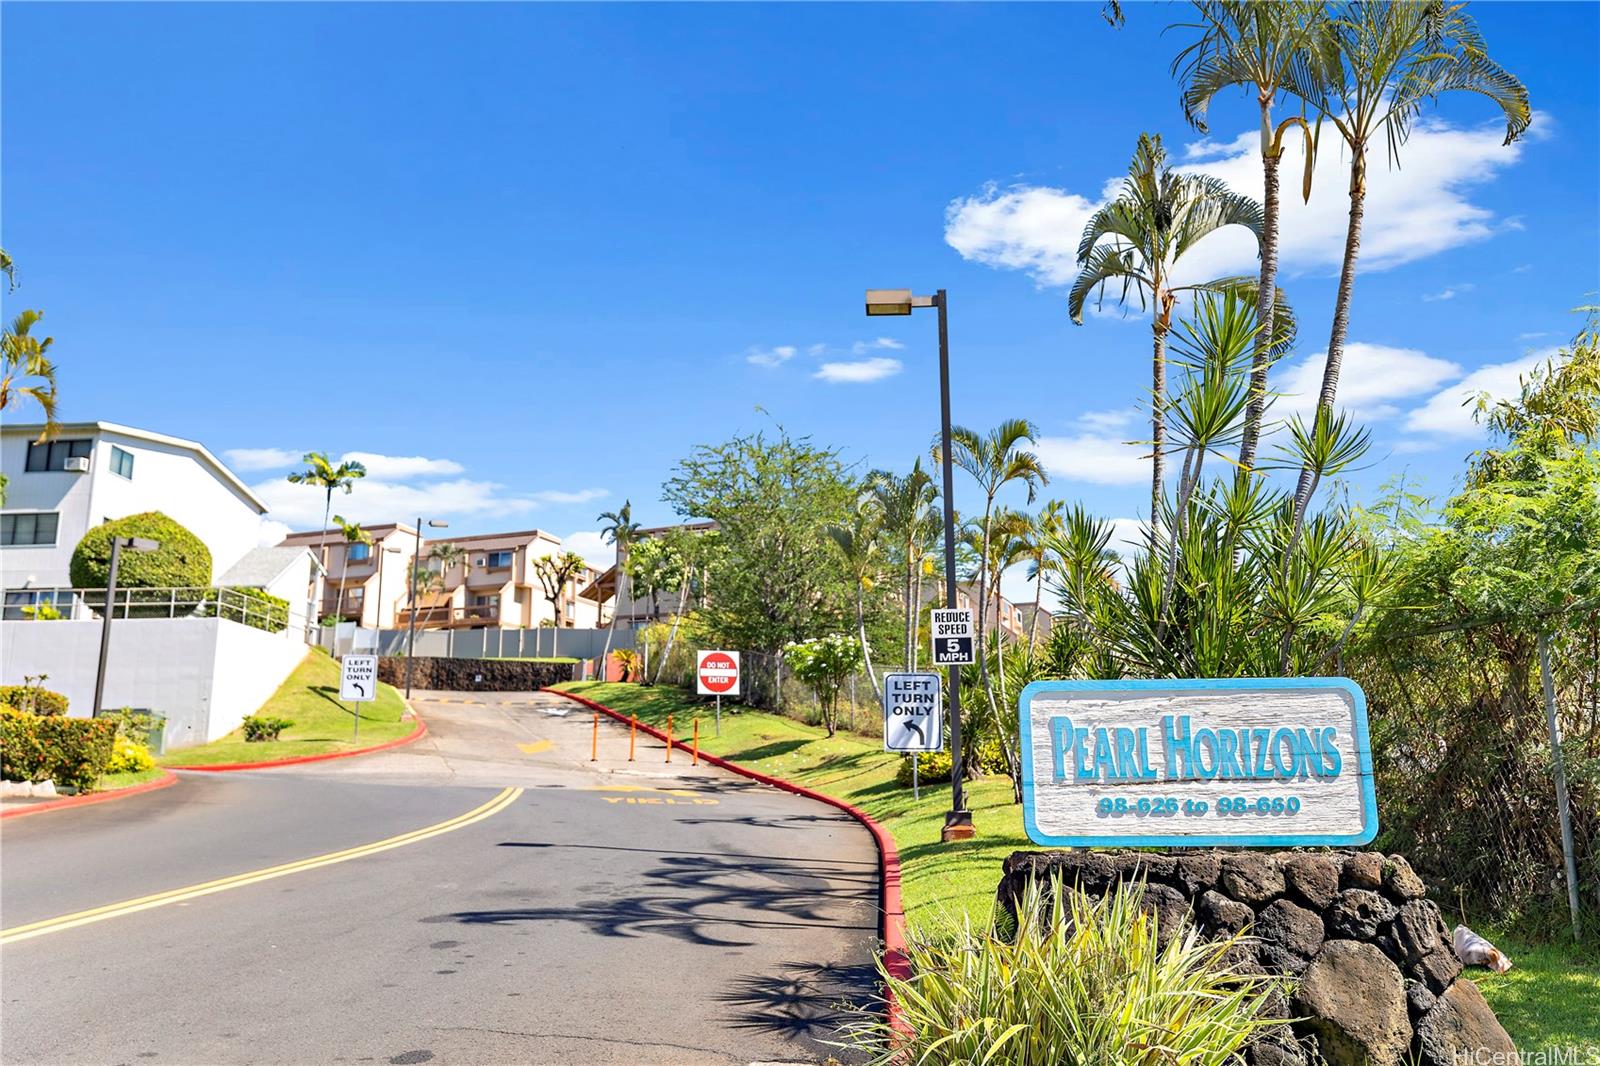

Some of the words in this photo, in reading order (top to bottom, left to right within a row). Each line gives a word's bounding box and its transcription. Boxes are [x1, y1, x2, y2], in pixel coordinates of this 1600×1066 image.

[934, 611, 971, 623] REDUCE
[938, 624, 967, 635] SPEED
[947, 638, 960, 652] 5
[939, 653, 969, 662] MPH
[707, 676, 729, 684] ENTER
[894, 681, 931, 691] LEFT
[892, 693, 934, 703] TURN
[892, 706, 933, 716] ONLY
[1049, 715, 1158, 783] PEARL
[1162, 715, 1343, 783] HORIZONS
[600, 797, 720, 805] YIELD
[1097, 796, 1178, 817] 98-626
[1182, 797, 1208, 815] to
[1214, 796, 1300, 817] 98-660
